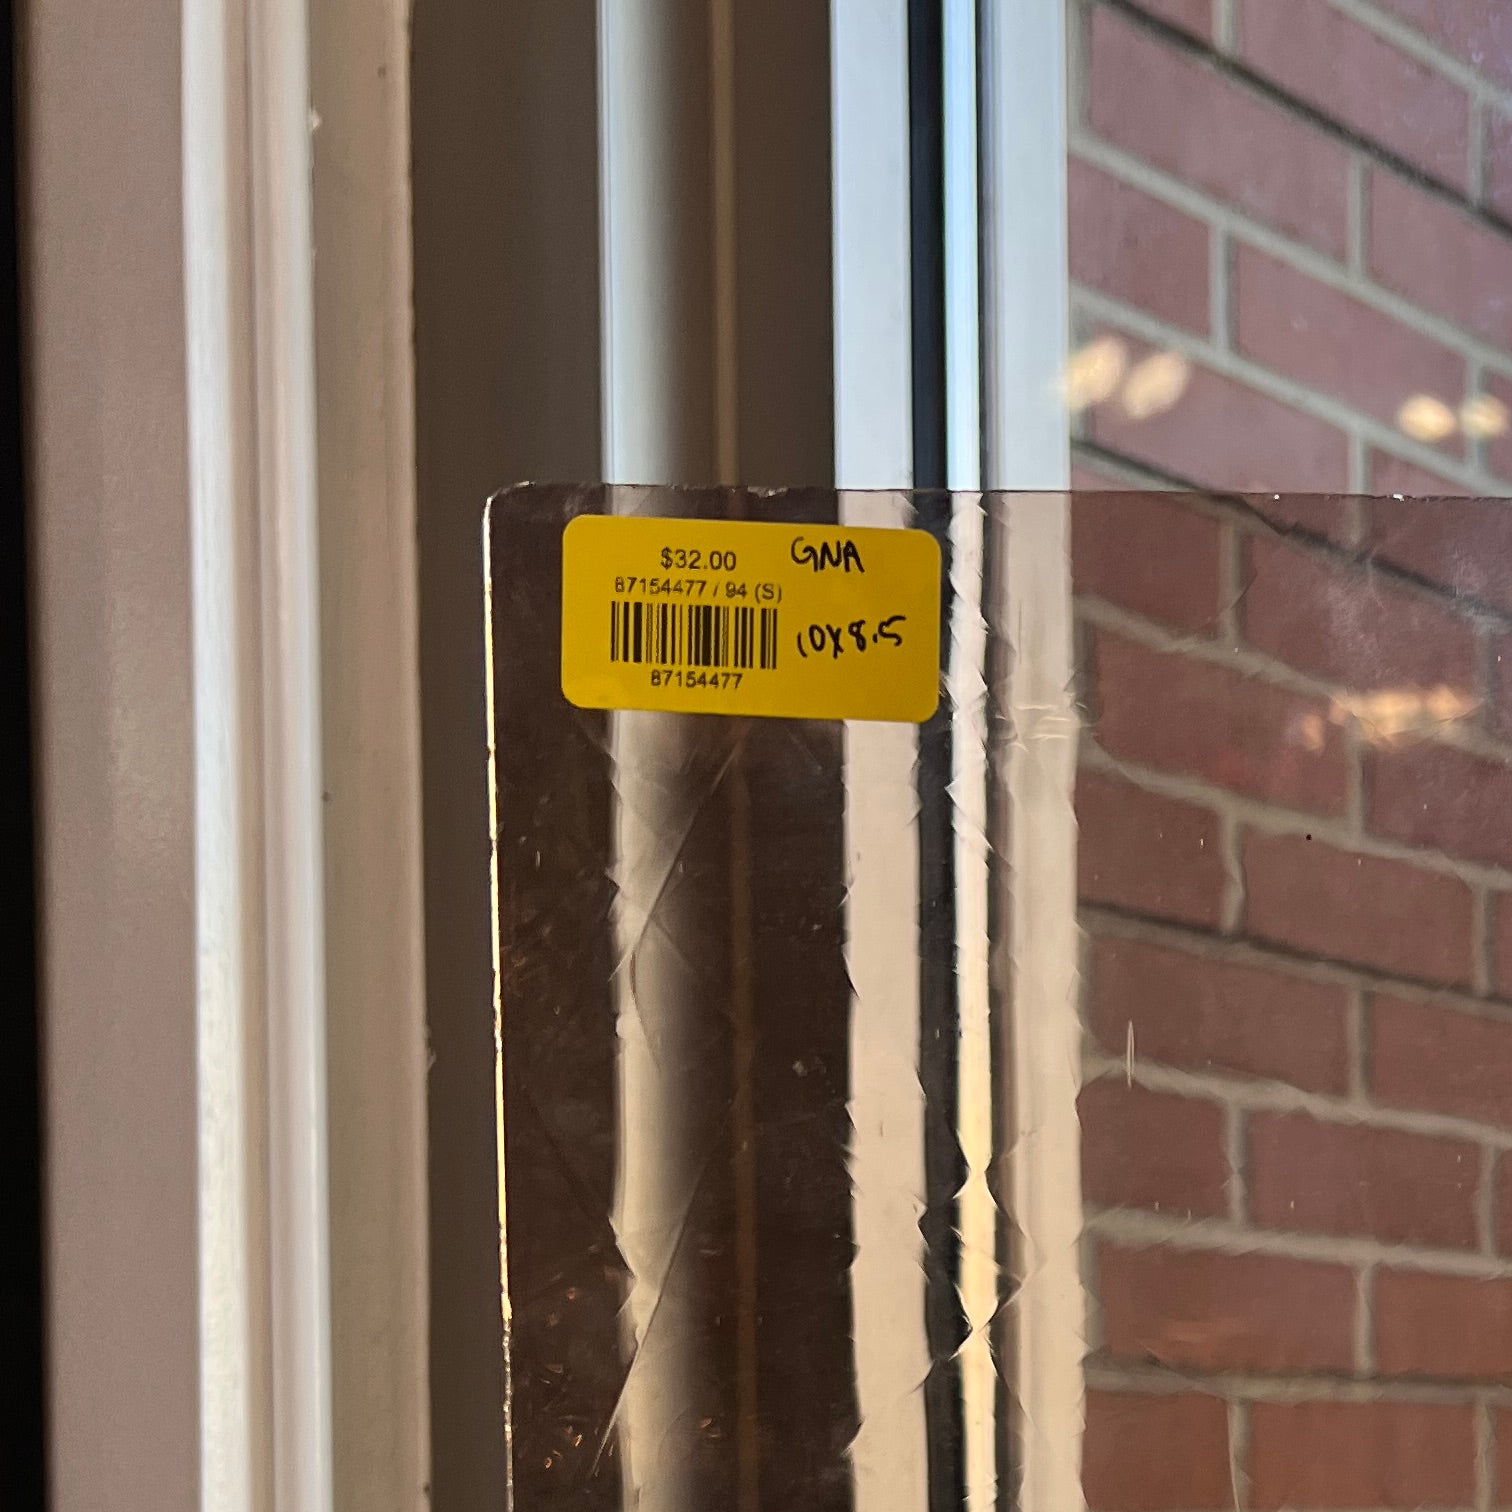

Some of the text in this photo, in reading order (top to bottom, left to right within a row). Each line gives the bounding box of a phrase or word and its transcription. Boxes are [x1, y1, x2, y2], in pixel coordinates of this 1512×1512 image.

[660, 547, 737, 571] $32.00
[791, 536, 865, 573] GNA
[615, 577, 707, 598] 87154477
[754, 583, 783, 604] (S)
[651, 669, 743, 690] 87154477
